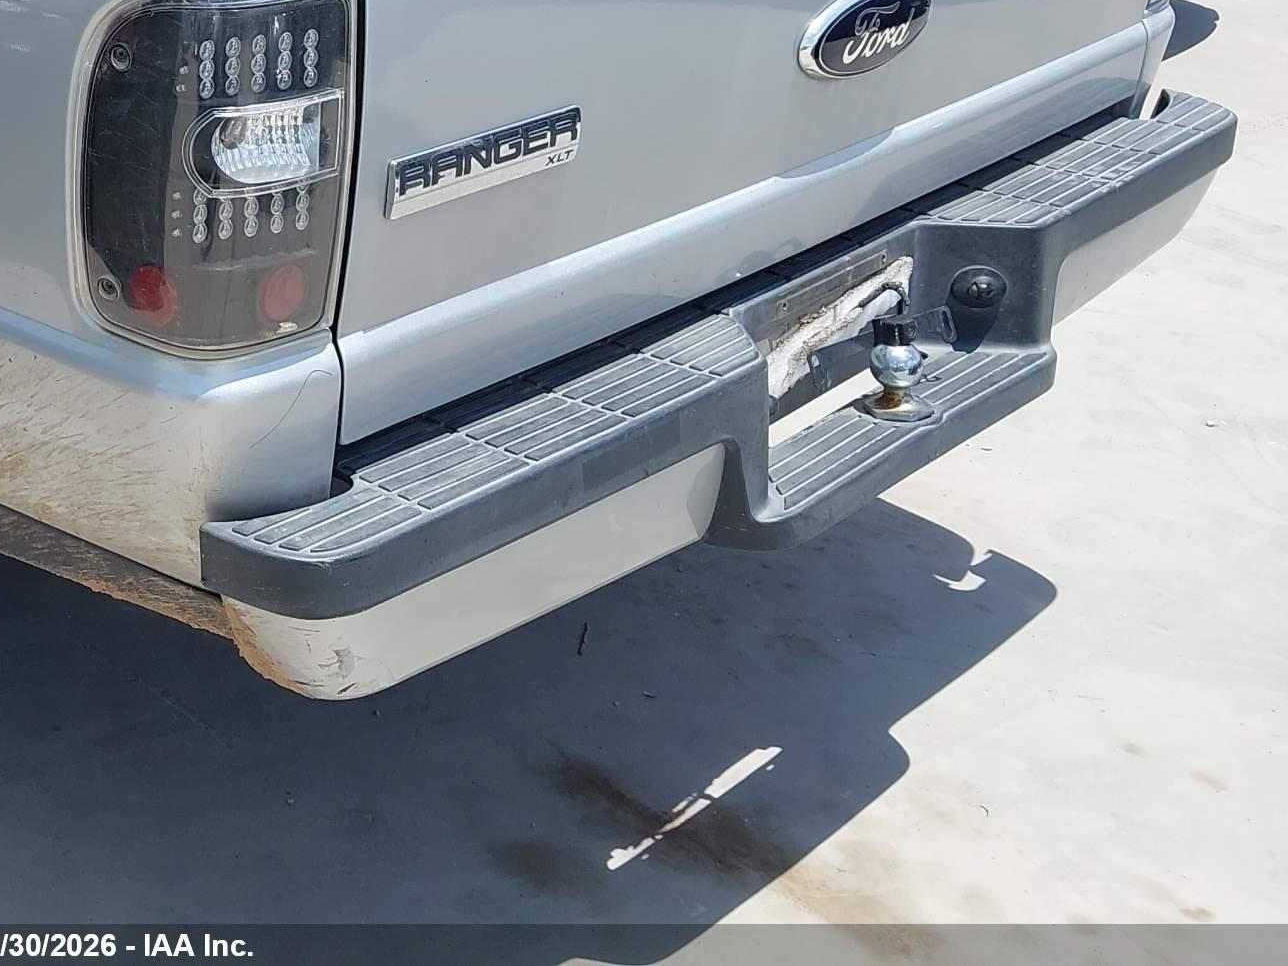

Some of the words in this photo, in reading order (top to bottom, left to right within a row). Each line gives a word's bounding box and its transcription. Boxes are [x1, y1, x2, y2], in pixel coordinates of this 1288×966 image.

[842, 1, 916, 64] Ford
[399, 108, 580, 196] RANGER
[545, 149, 574, 166] XLT
